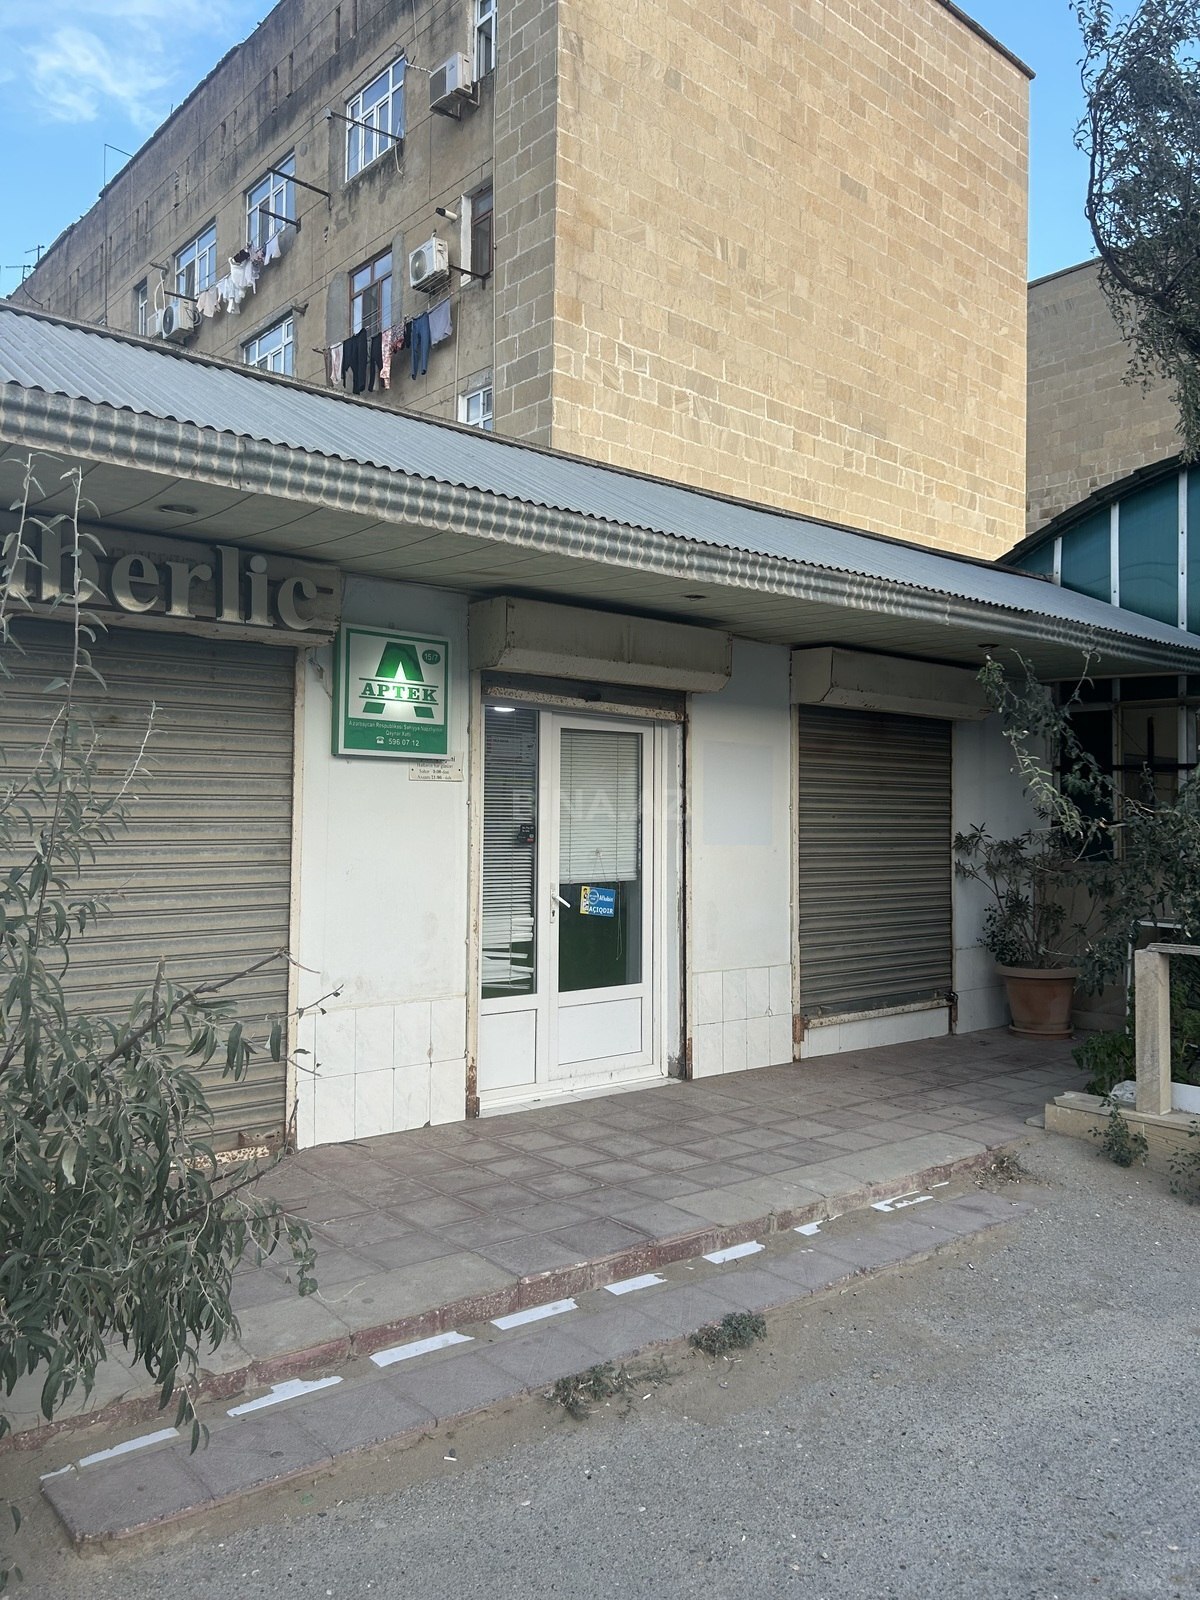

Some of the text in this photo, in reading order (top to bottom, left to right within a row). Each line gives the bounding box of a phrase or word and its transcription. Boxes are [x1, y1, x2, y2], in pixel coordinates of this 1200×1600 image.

[424, 652, 439, 662] 15/7
[361, 682, 438, 703] APTEK
[388, 738, 420, 747] 596 07 12
